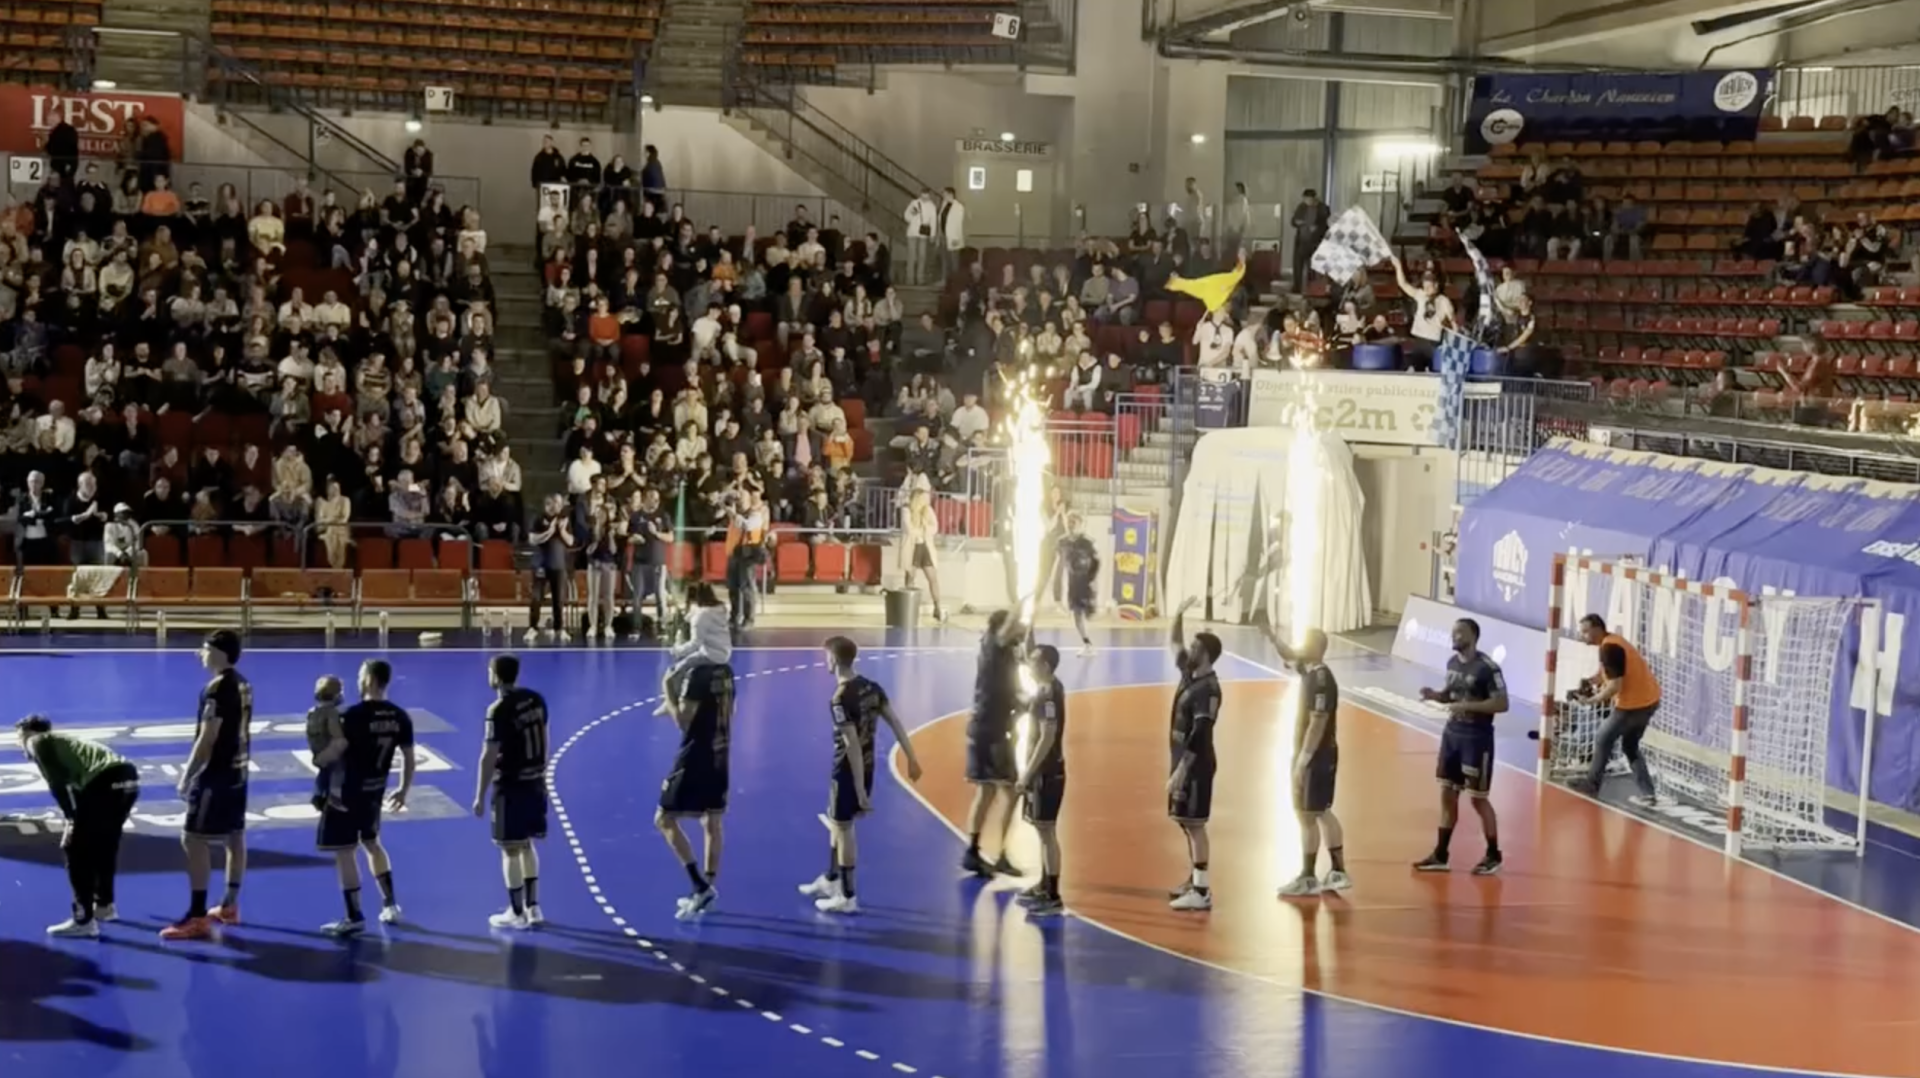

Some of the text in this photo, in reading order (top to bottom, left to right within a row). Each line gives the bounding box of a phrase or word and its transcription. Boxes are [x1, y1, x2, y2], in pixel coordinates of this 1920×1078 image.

[1008, 18, 1017, 36] 6
[443, 90, 451, 108] 7
[31, 95, 145, 133] L'EST
[962, 140, 1047, 155] BRASSERIE
[30, 161, 40, 180] 2
[1366, 385, 1438, 399] publicitair
[1563, 546, 1796, 685] NANCY
[376, 736, 392, 769] 7
